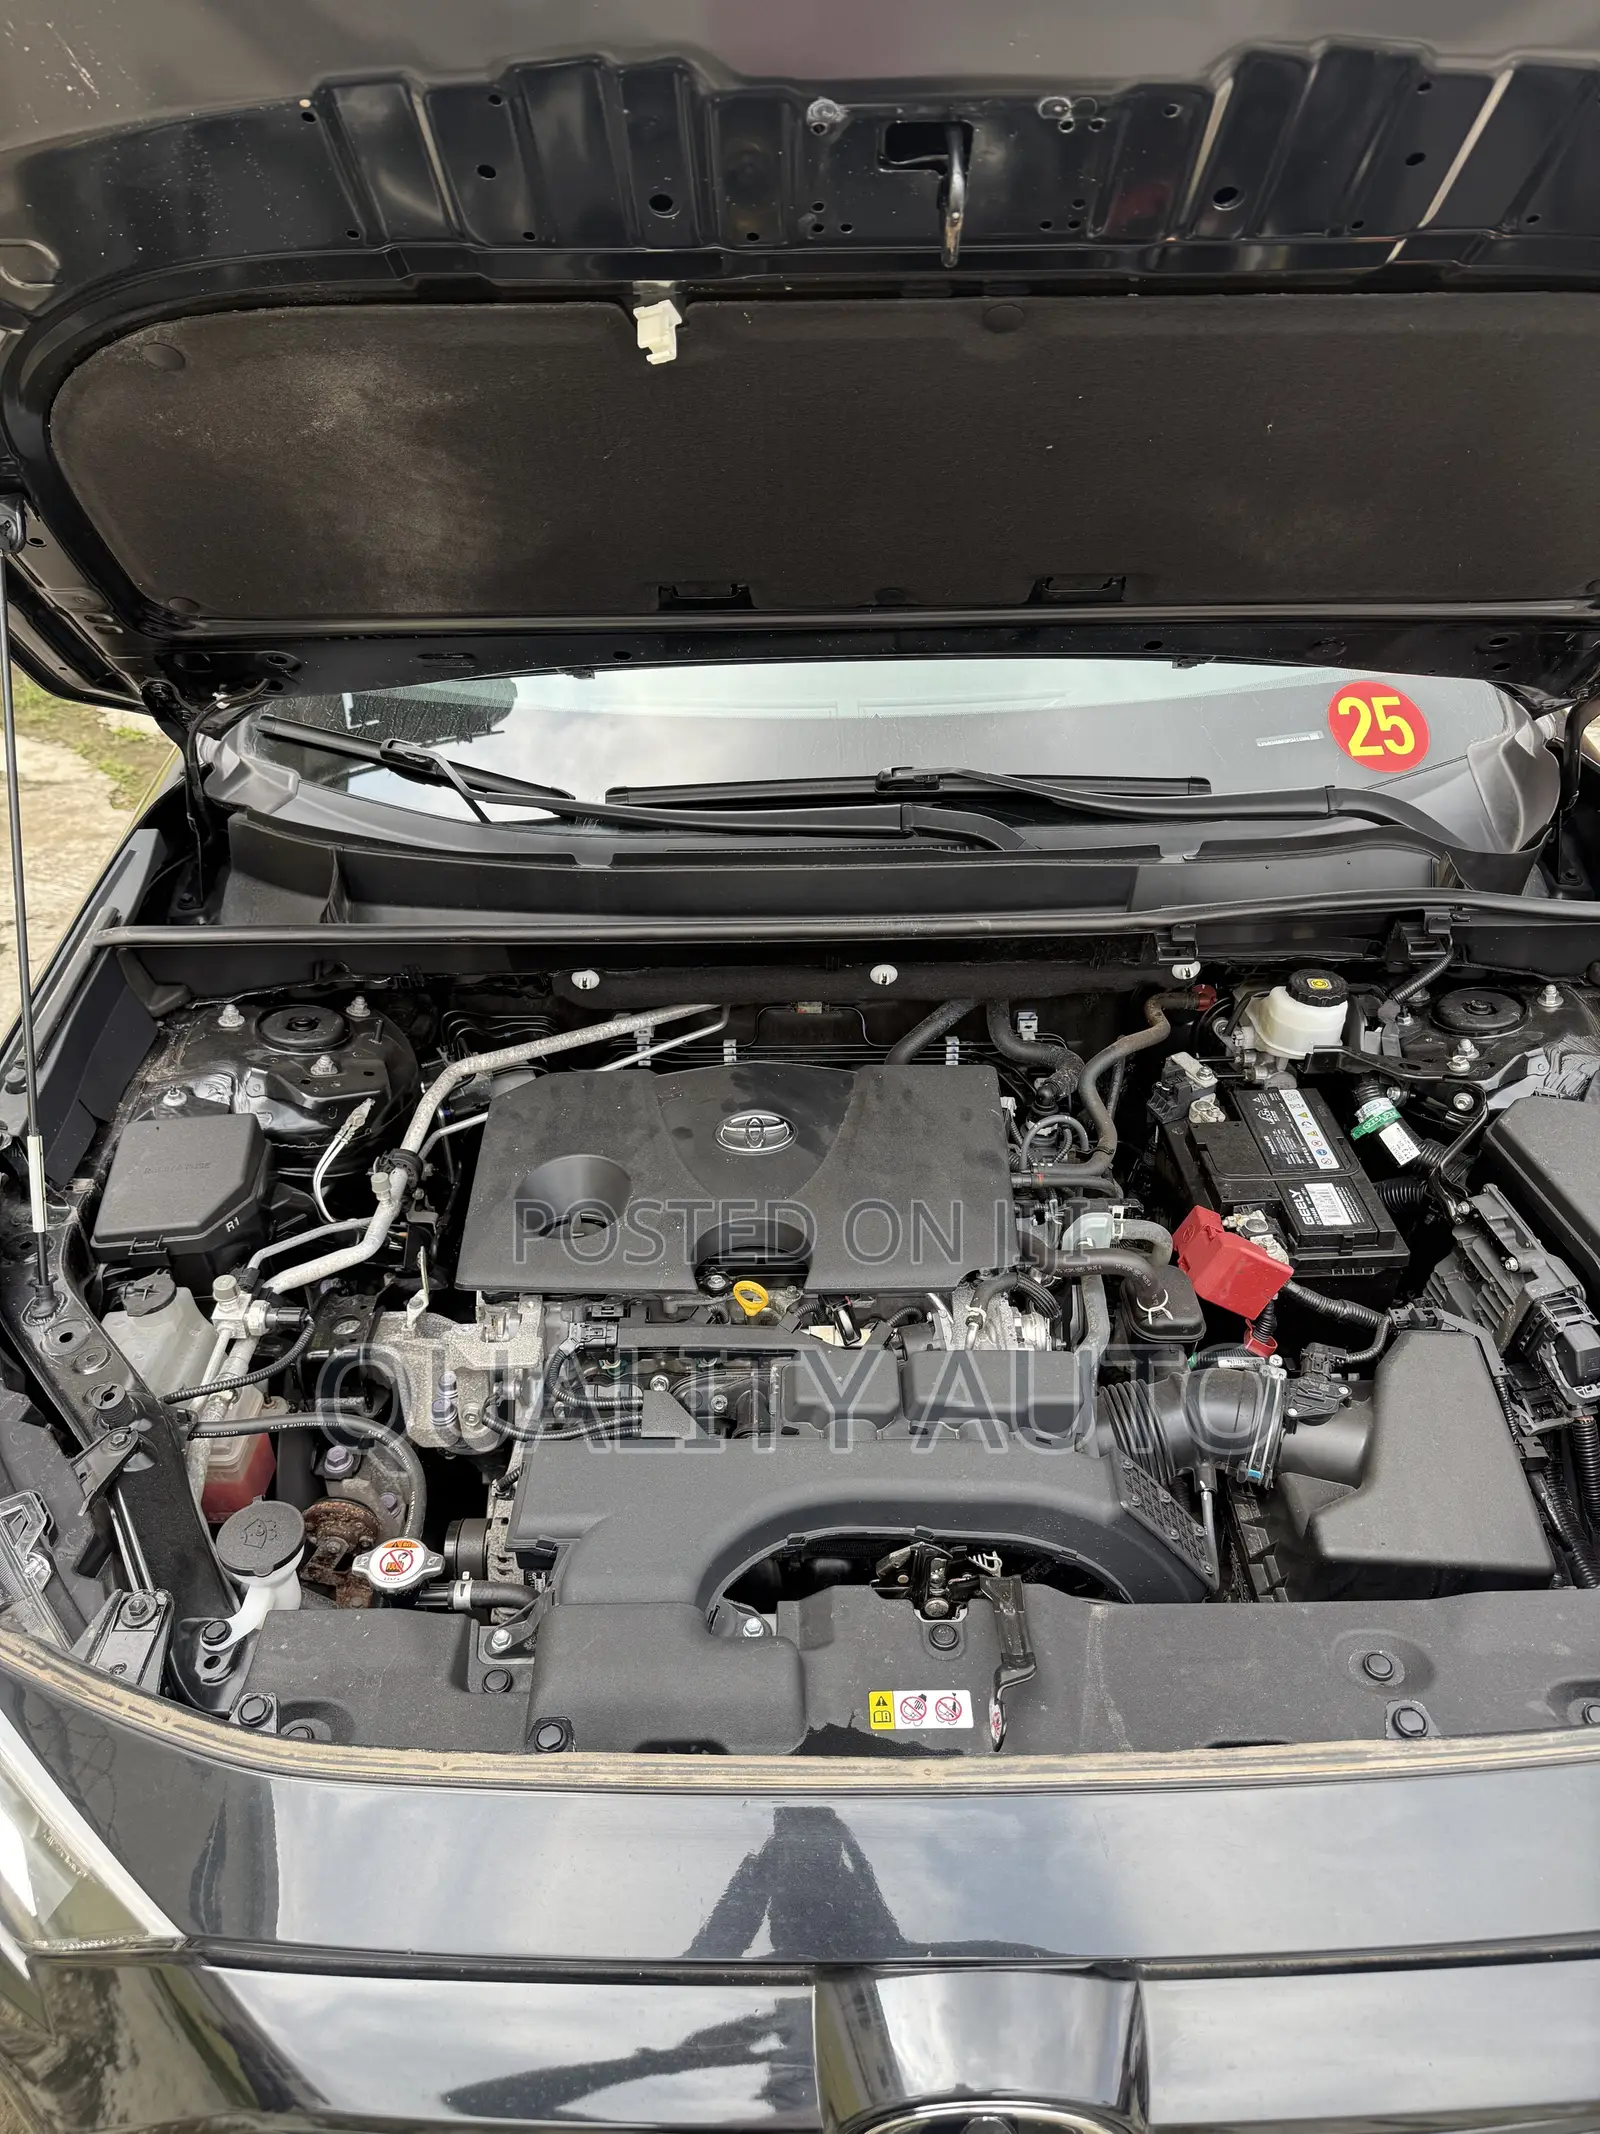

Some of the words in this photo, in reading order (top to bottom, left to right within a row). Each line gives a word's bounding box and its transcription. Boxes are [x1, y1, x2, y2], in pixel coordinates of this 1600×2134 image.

[1338, 697, 1415, 757] 25
[225, 1216, 240, 1233] R1
[1289, 1188, 1315, 1225] GEELY
